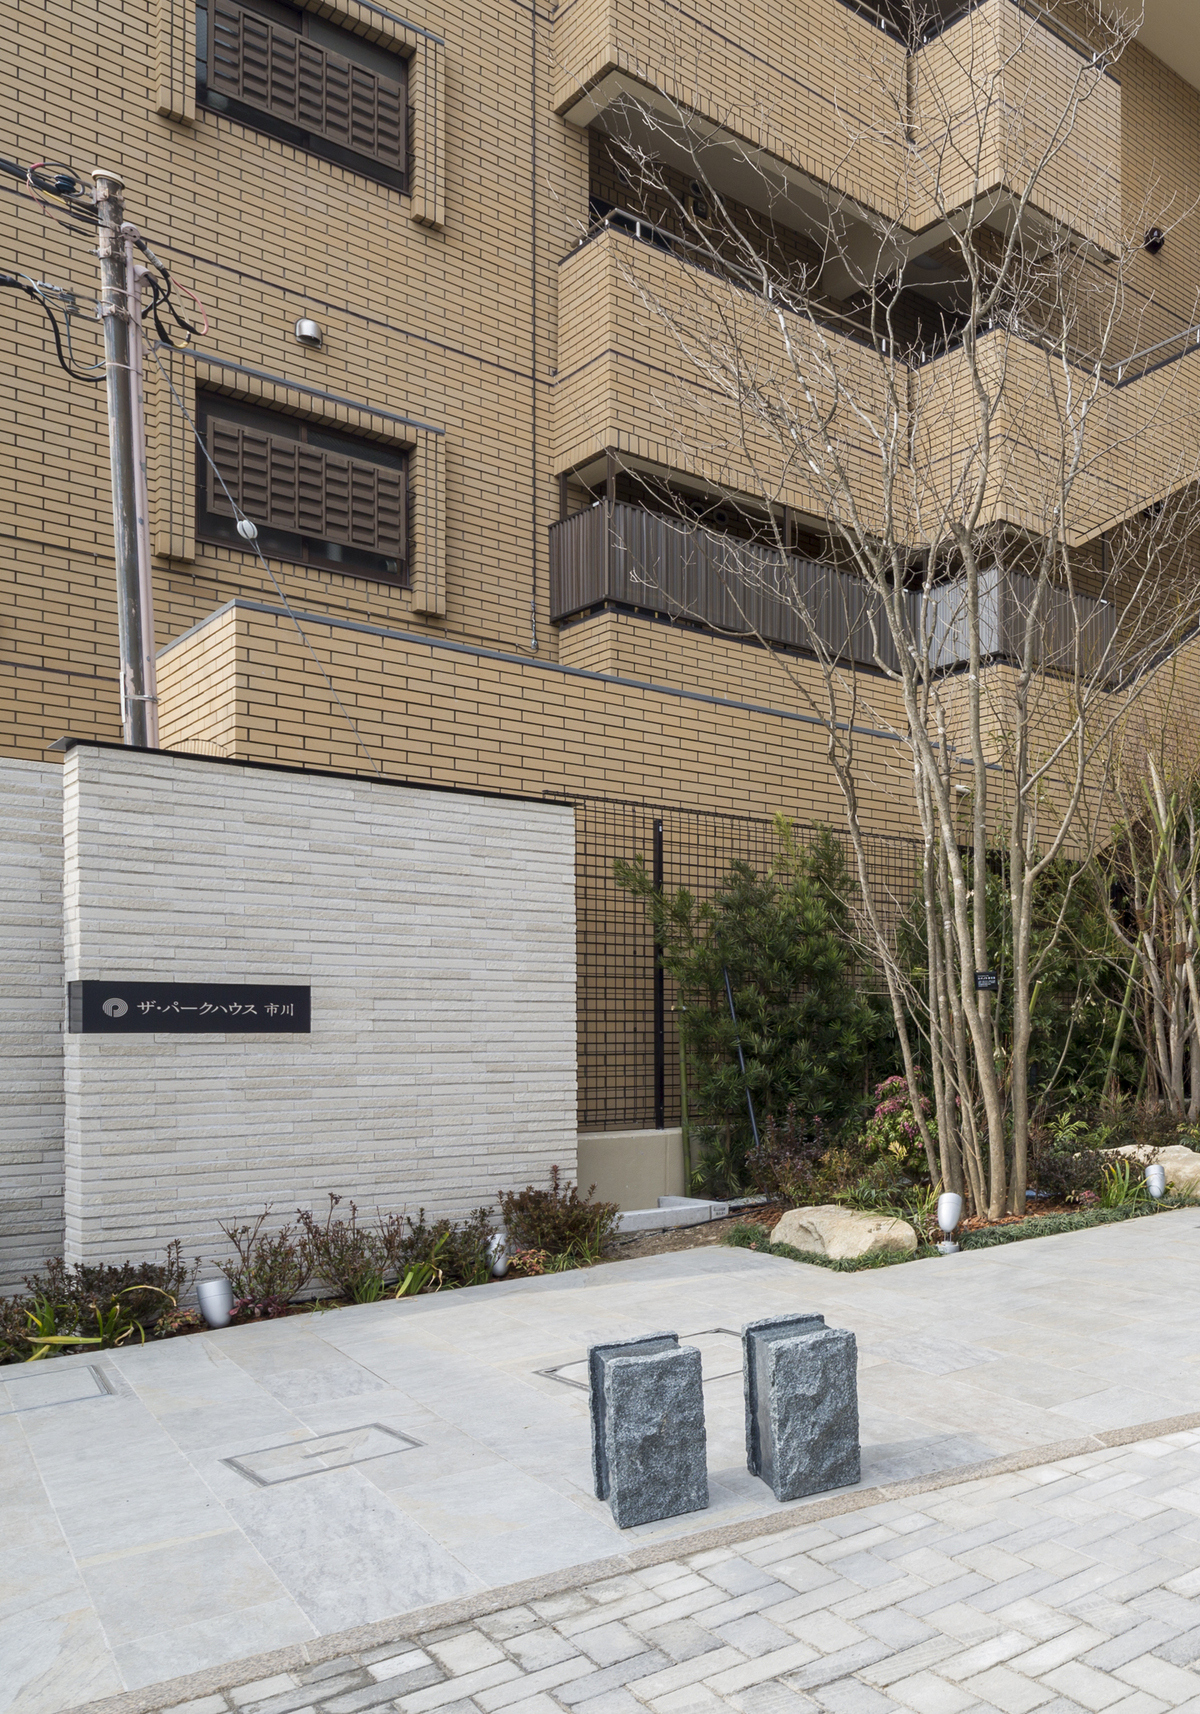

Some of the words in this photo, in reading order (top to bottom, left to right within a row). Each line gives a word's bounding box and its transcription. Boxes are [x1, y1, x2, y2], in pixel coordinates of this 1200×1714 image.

[136, 1000, 258, 1016] ザ・パークハウス
[264, 1002, 294, 1017] 市川
